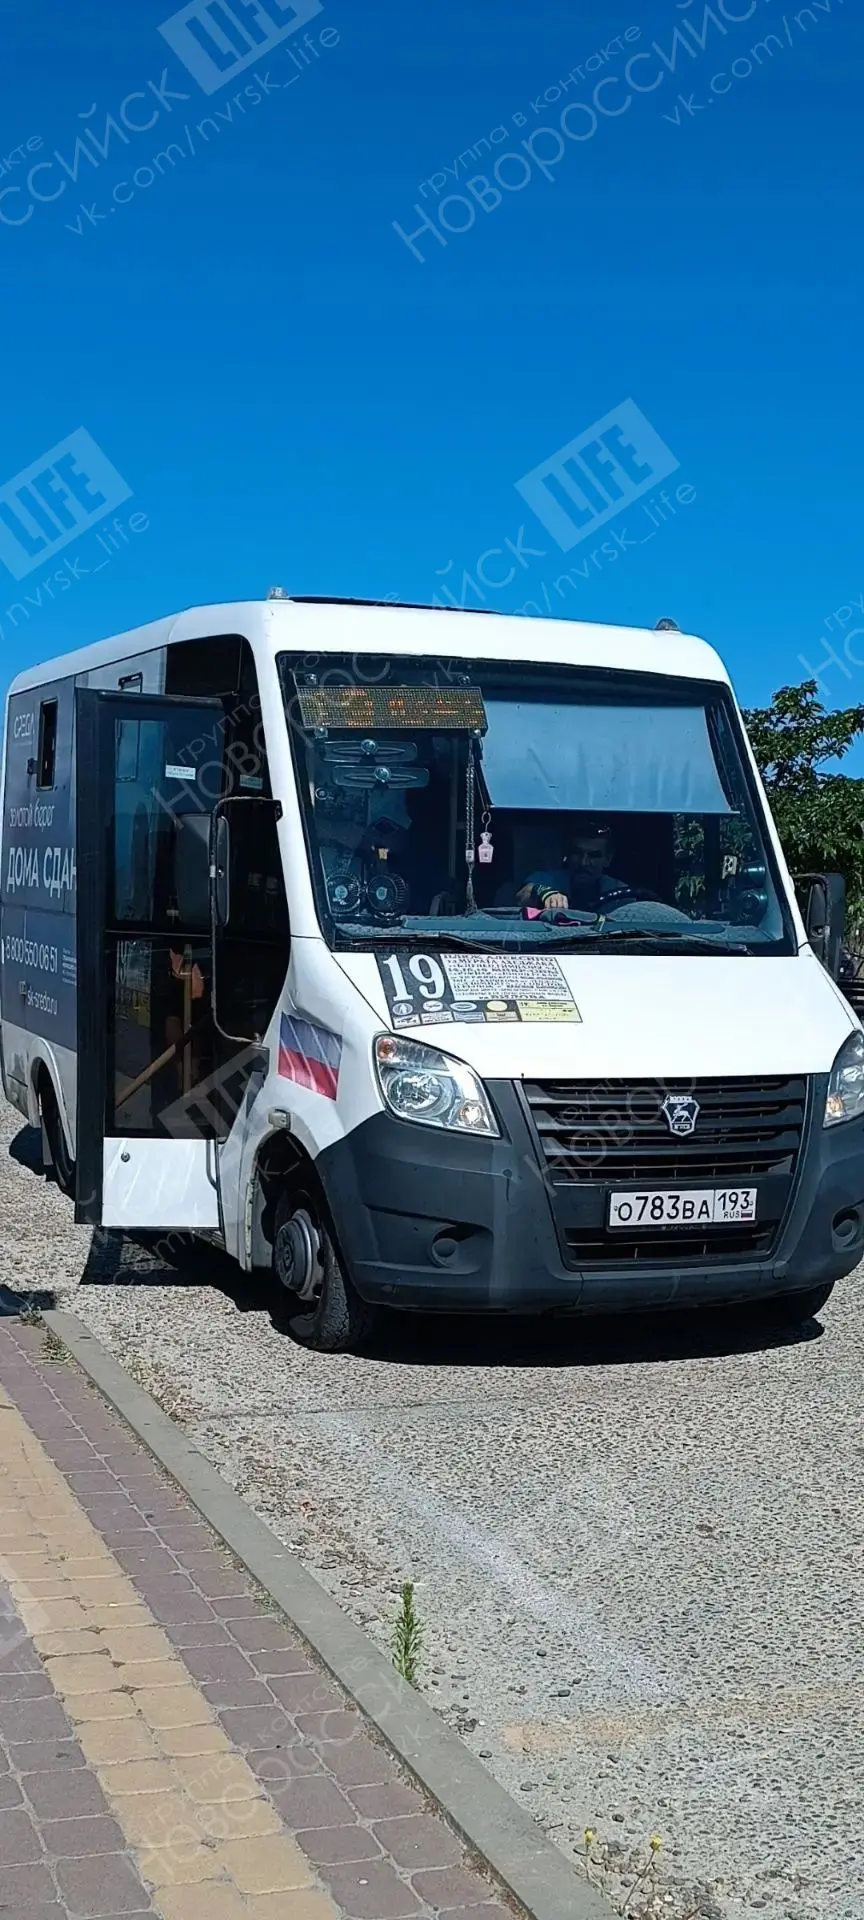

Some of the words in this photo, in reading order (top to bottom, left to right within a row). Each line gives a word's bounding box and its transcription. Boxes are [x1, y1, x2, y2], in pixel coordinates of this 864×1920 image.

[6, 846, 39, 893] ДОМА
[6, 935, 11, 959] 8
[11, 936, 24, 963] 800
[24, 940, 39, 967] 550
[39, 943, 49, 971] 06
[50, 946, 58, 973] 51
[383, 953, 446, 1002] 19
[718, 1191, 750, 1211] 193
[723, 1211, 740, 1219] RUS
